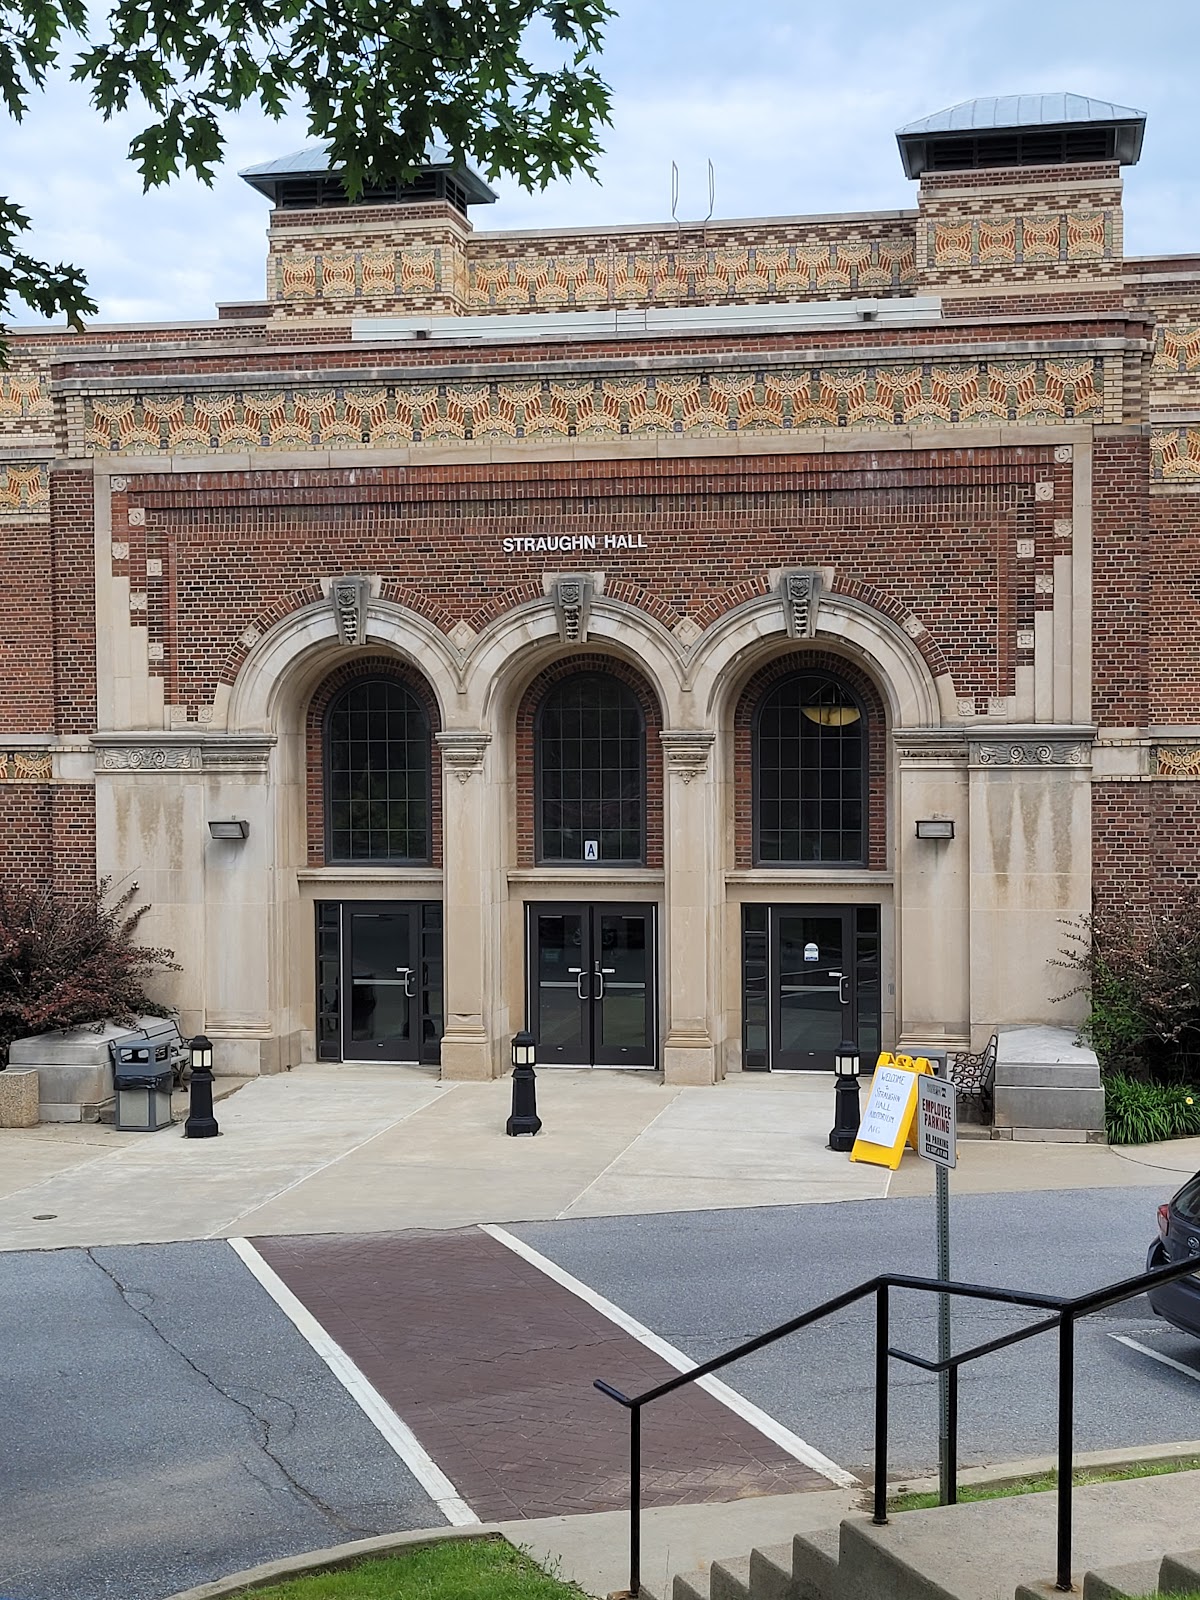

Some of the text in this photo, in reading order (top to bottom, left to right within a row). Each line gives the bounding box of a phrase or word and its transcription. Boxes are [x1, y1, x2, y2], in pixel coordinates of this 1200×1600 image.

[502, 533, 648, 553] STRAUGHN HALL
[587, 843, 595, 857] A
[881, 1072, 905, 1085] WELCOME
[875, 1100, 892, 1111] HALL
[922, 1098, 952, 1120] EMPLOYEE
[924, 1112, 950, 1134] PARKING
[925, 1132, 949, 1149] NO PARKING
